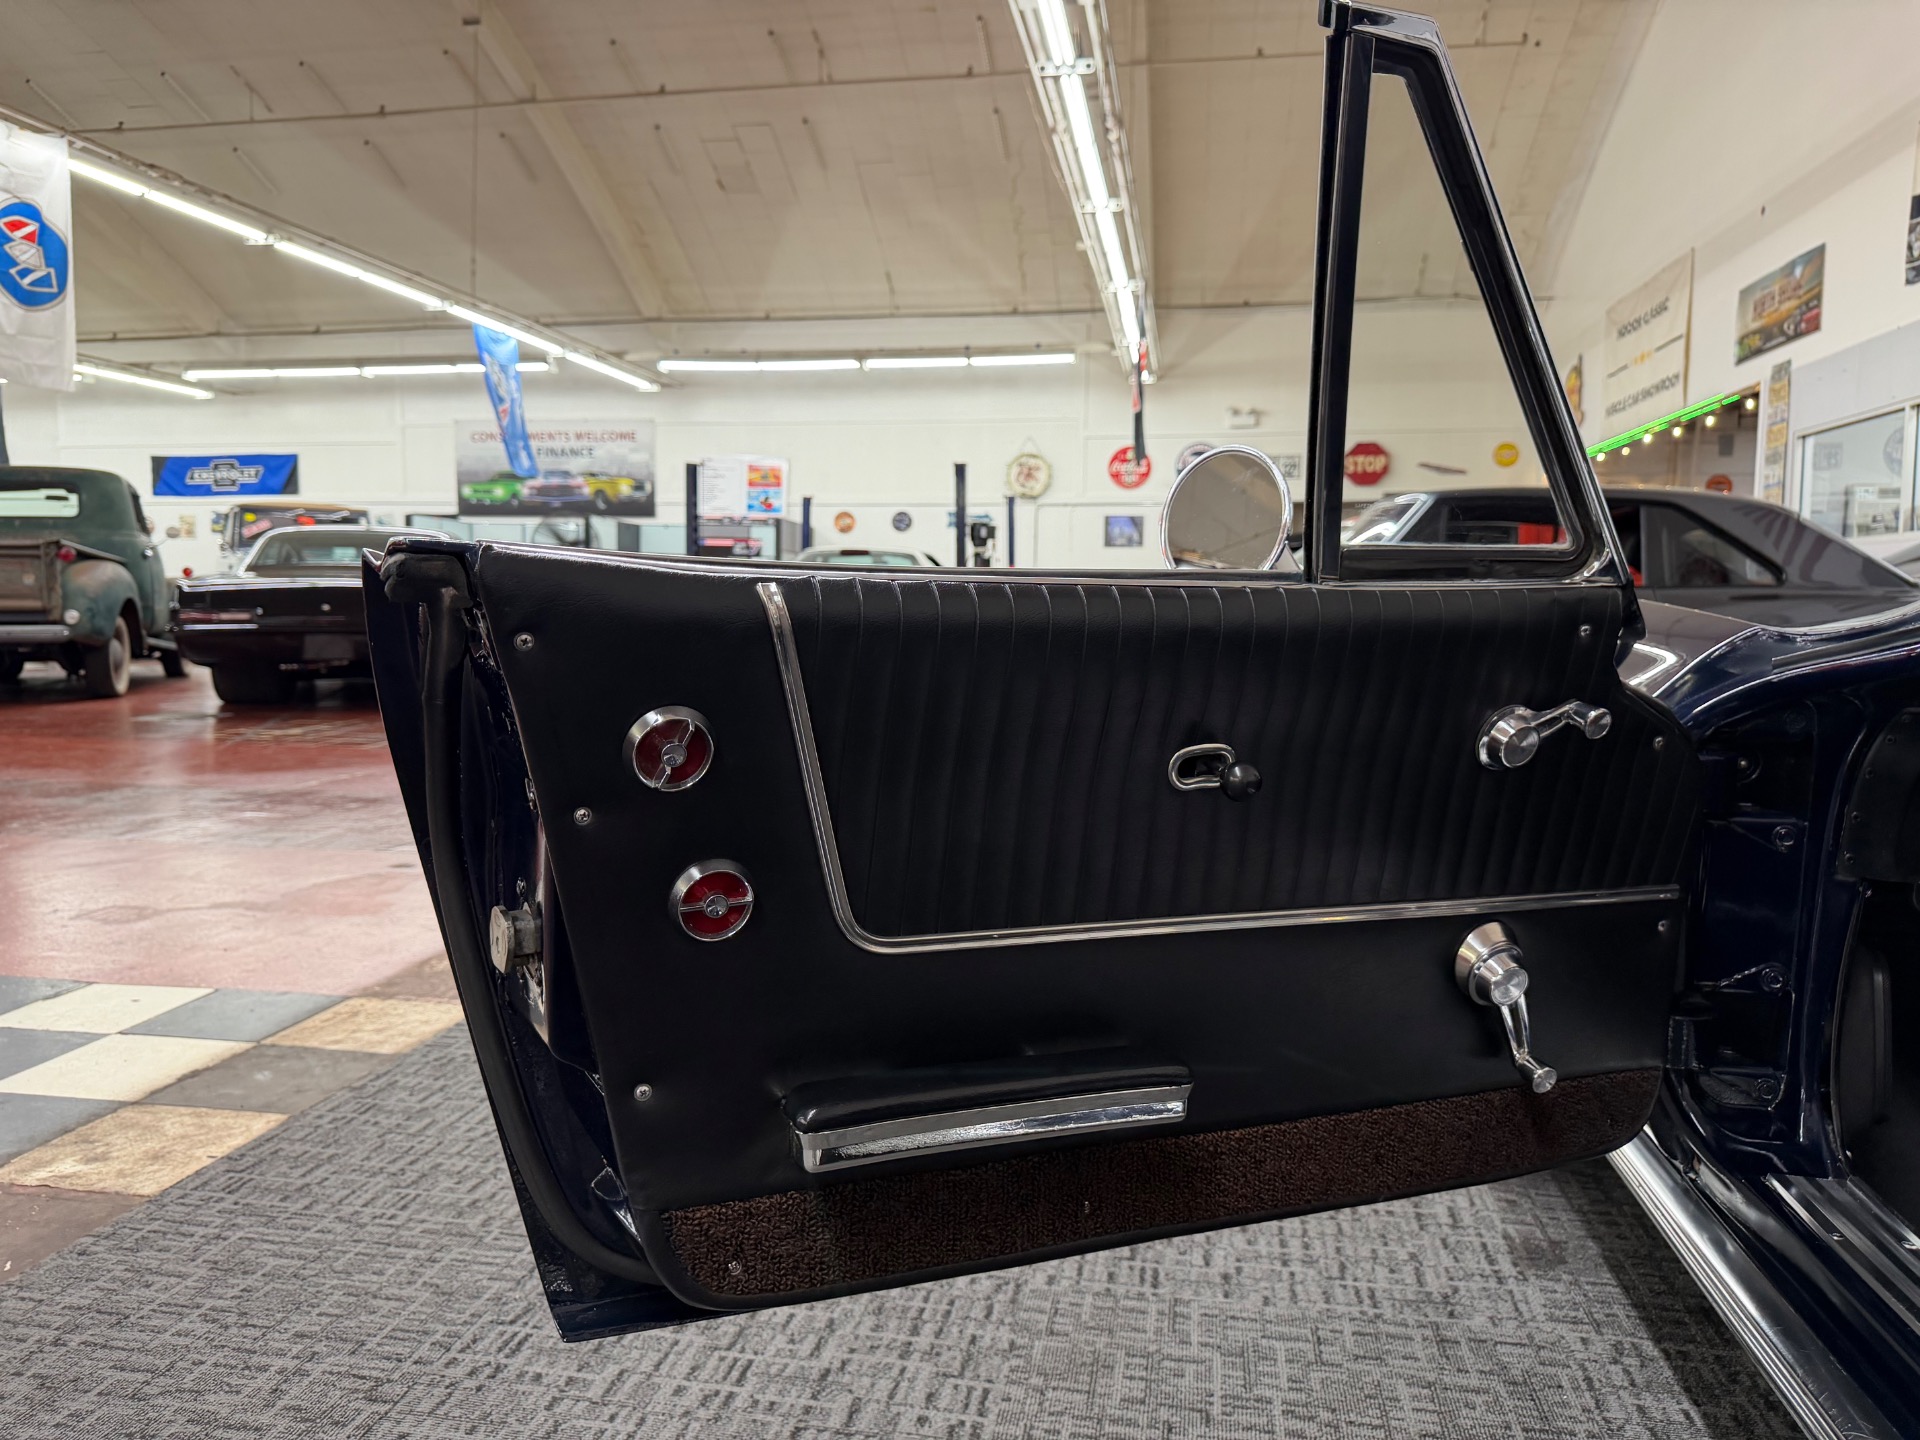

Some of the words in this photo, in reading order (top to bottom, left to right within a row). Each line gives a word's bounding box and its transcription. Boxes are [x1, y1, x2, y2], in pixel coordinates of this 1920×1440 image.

[470, 431, 569, 443] CONSMENTS
[574, 431, 638, 442] WELCOME
[536, 446, 596, 459] FINANCE
[1345, 454, 1386, 473] STOP
